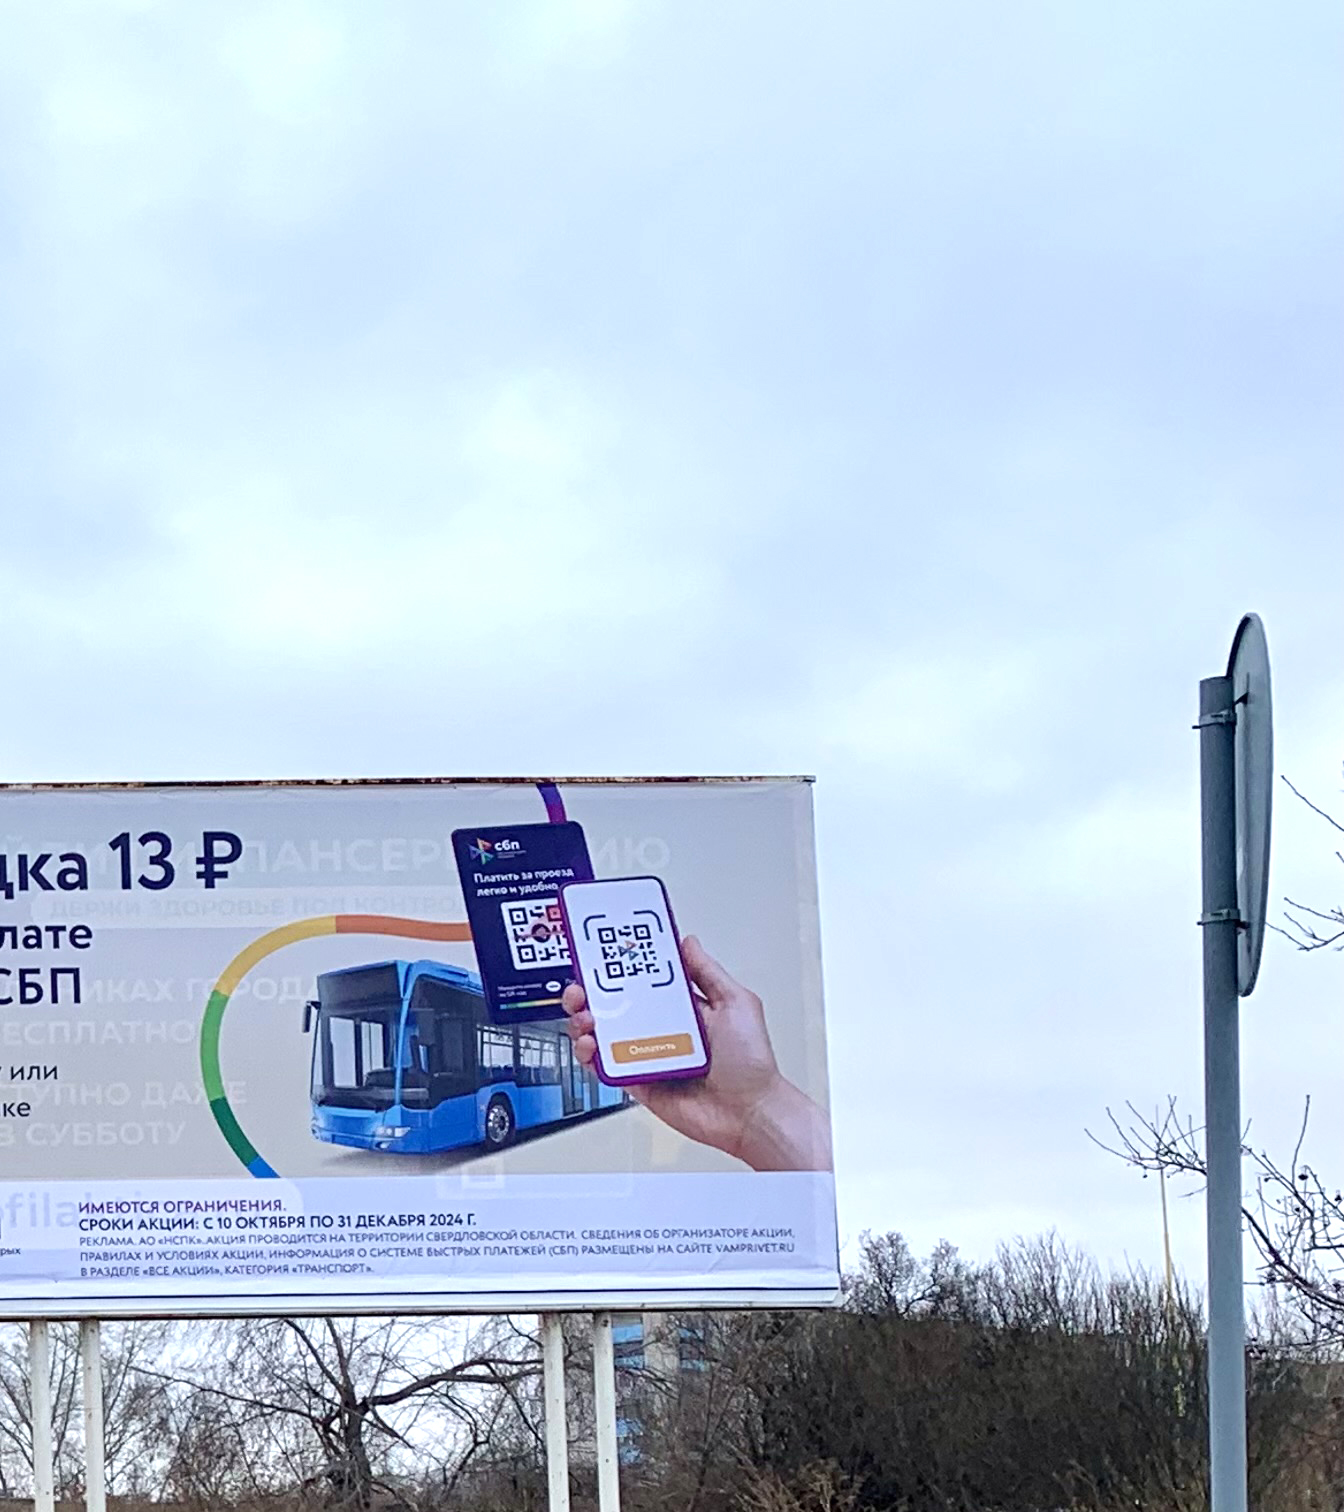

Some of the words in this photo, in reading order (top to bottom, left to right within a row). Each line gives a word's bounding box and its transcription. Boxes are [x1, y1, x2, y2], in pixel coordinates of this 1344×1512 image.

[494, 840, 520, 851] сбп
[109, 831, 174, 890] 13
[195, 831, 242, 889] ₽
[474, 872, 519, 883] Платить
[534, 868, 574, 880] проезд
[477, 886, 507, 896] легко
[518, 881, 558, 895] удобно
[10, 1064, 59, 1082] или
[79, 1200, 159, 1214] ИМЕЮТСЯ
[163, 1199, 287, 1213] ОГРАНИЧЕНИЯ.
[79, 1218, 133, 1231] СРОКИ
[137, 1217, 199, 1231] АКЦИИ:
[203, 1217, 213, 1229] С
[217, 1217, 232, 1229] 10
[236, 1216, 305, 1229] ОКТЯБРЯ
[311, 1215, 333, 1228] ПО
[338, 1215, 352, 1228] 31
[355, 1214, 425, 1229] ДЕКАБРЯ
[429, 1213, 464, 1226] 2024
[467, 1213, 477, 1226] Г.
[80, 1236, 136, 1246] РЕКЛАМА.
[139, 1236, 156, 1245] АО
[206, 1234, 246, 1245] АКЦИЯ
[249, 1233, 327, 1244] ПРОВОДИТСЯ
[330, 1233, 346, 1243] НА
[348, 1232, 424, 1243] ТЕРРИТОРИИ
[426, 1230, 516, 1242] СВЕРДЛОВСКОЙ
[581, 1230, 641, 1240] СВЕДЕНИЯ
[644, 1229, 659, 1239] ОБ
[662, 1229, 749, 1239] ОРГАНИЗАТОРЕ
[80, 1252, 141, 1261] ПРАВИЛАХ
[145, 1252, 153, 1261] И
[157, 1251, 218, 1261] УСЛОВИЯХ
[269, 1249, 355, 1260] ИНФОРМАЦИЯ
[357, 1248, 367, 1258] О
[370, 1248, 423, 1258] СИСТЕМЕ
[426, 1247, 480, 1257] БЫСТРЫХ
[483, 1244, 545, 1256] ПЛАТЕЖЕЙ
[549, 1245, 579, 1257] (СБП)
[581, 1245, 653, 1256] РАЗМЕЩЕНЫ
[657, 1245, 674, 1254] НА
[676, 1243, 712, 1254] САЙТЕ
[715, 1243, 795, 1254] VAMPRIVET.RU
[81, 1267, 87, 1277] В
[90, 1267, 140, 1277] РАЗДЕЛЕ
[142, 1266, 169, 1276] «ВСЕ
[225, 1264, 289, 1275] КАТЕГОРИЯ
